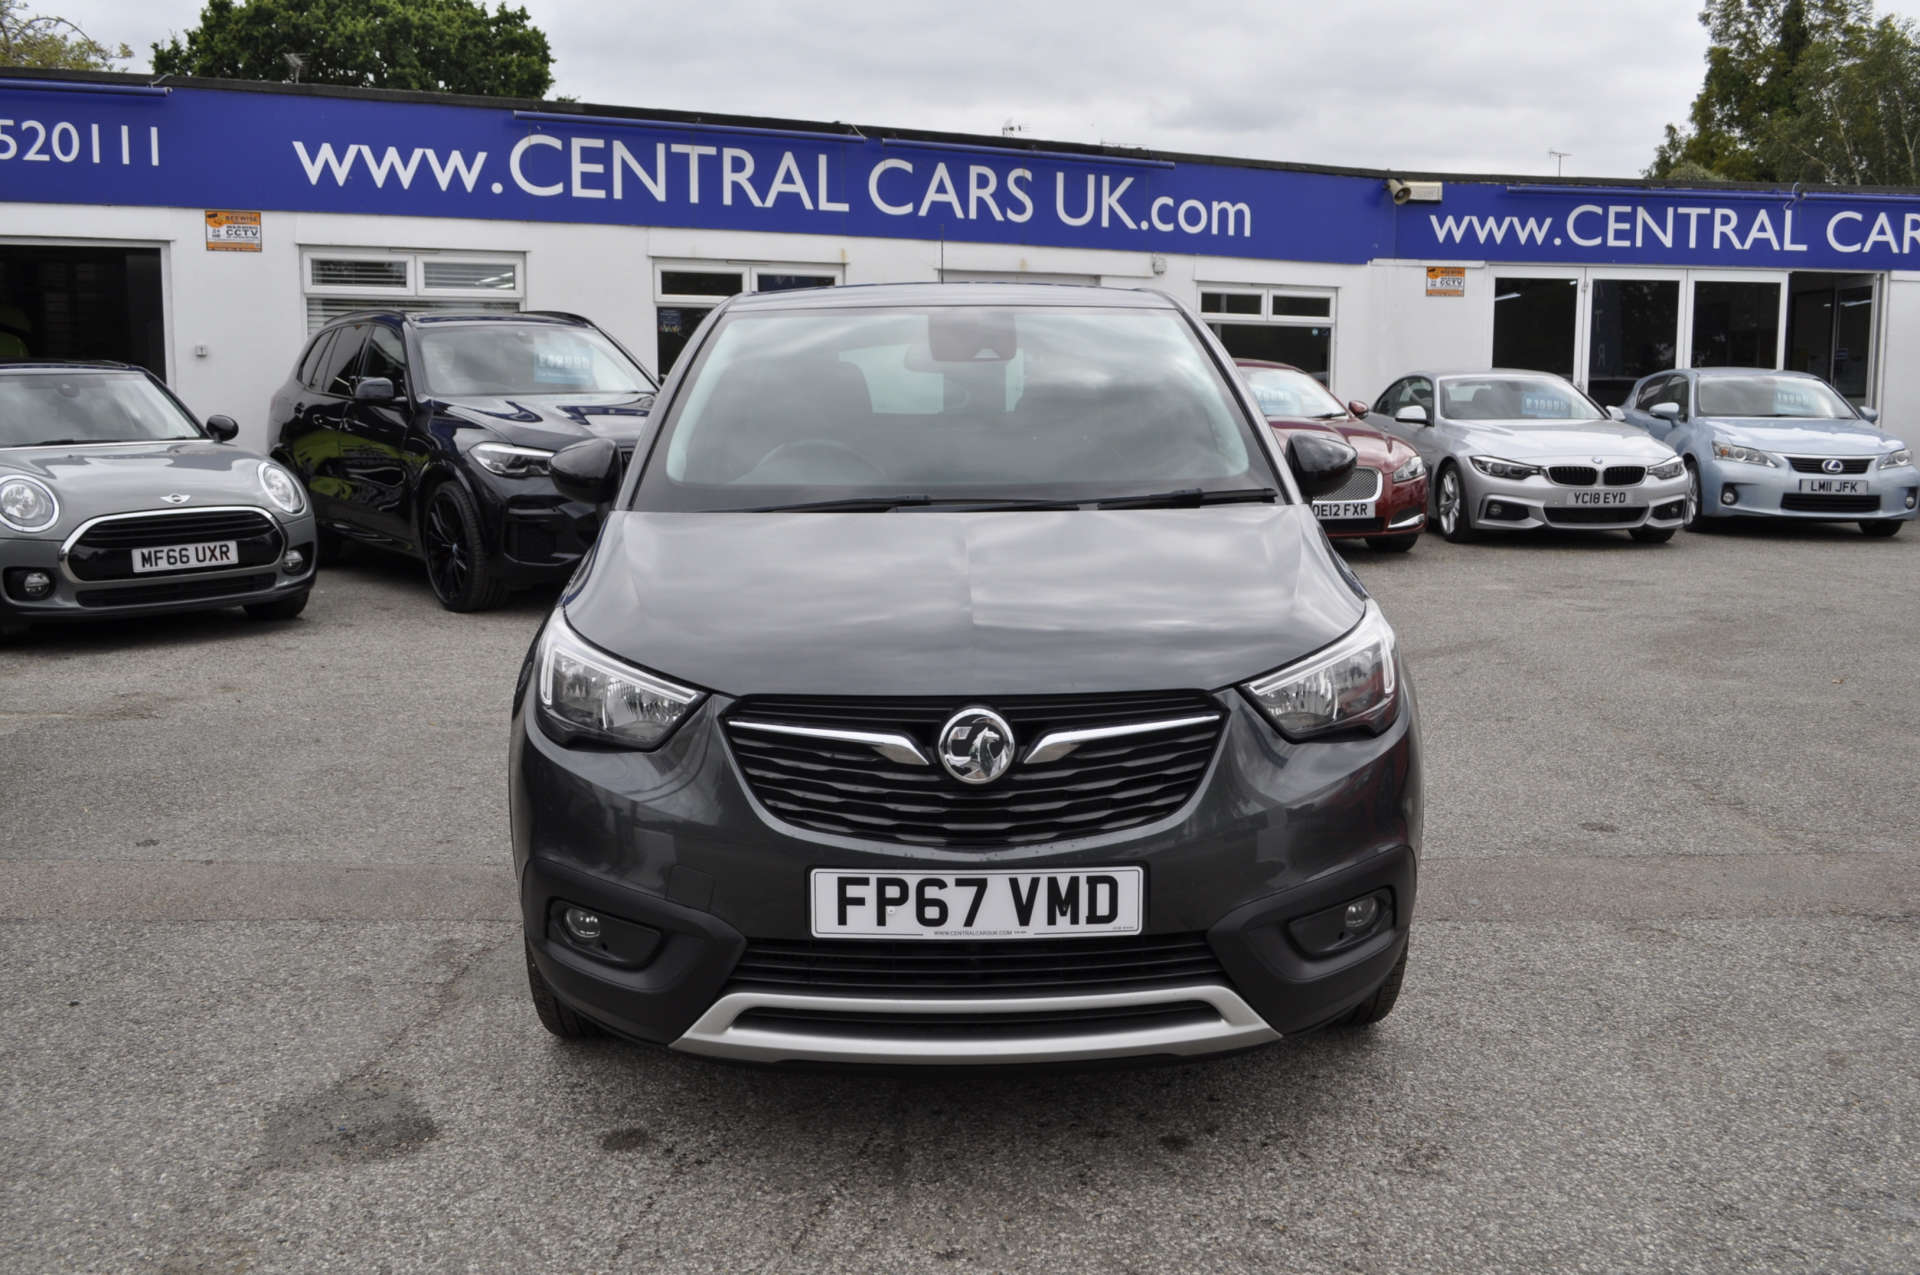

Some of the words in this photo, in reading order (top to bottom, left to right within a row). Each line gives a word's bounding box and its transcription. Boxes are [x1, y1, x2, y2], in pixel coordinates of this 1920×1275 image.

[292, 134, 850, 212] www.CENTRAL
[868, 158, 1035, 223] CARS
[1056, 171, 1251, 237] UK.com
[226, 229, 258, 237] CCTV
[1429, 203, 1808, 252] www.CENTRAL
[1826, 210, 1920, 254] CAR
[1810, 481, 1832, 492] LM11
[1835, 481, 1858, 493] JFK
[1574, 492, 1601, 504] YC18
[1603, 492, 1627, 504] EYD
[1344, 503, 1368, 517] FXR
[141, 547, 190, 569] MF66
[195, 543, 231, 564] UXR
[836, 876, 989, 928] FP67
[1008, 874, 1119, 928] VMD
